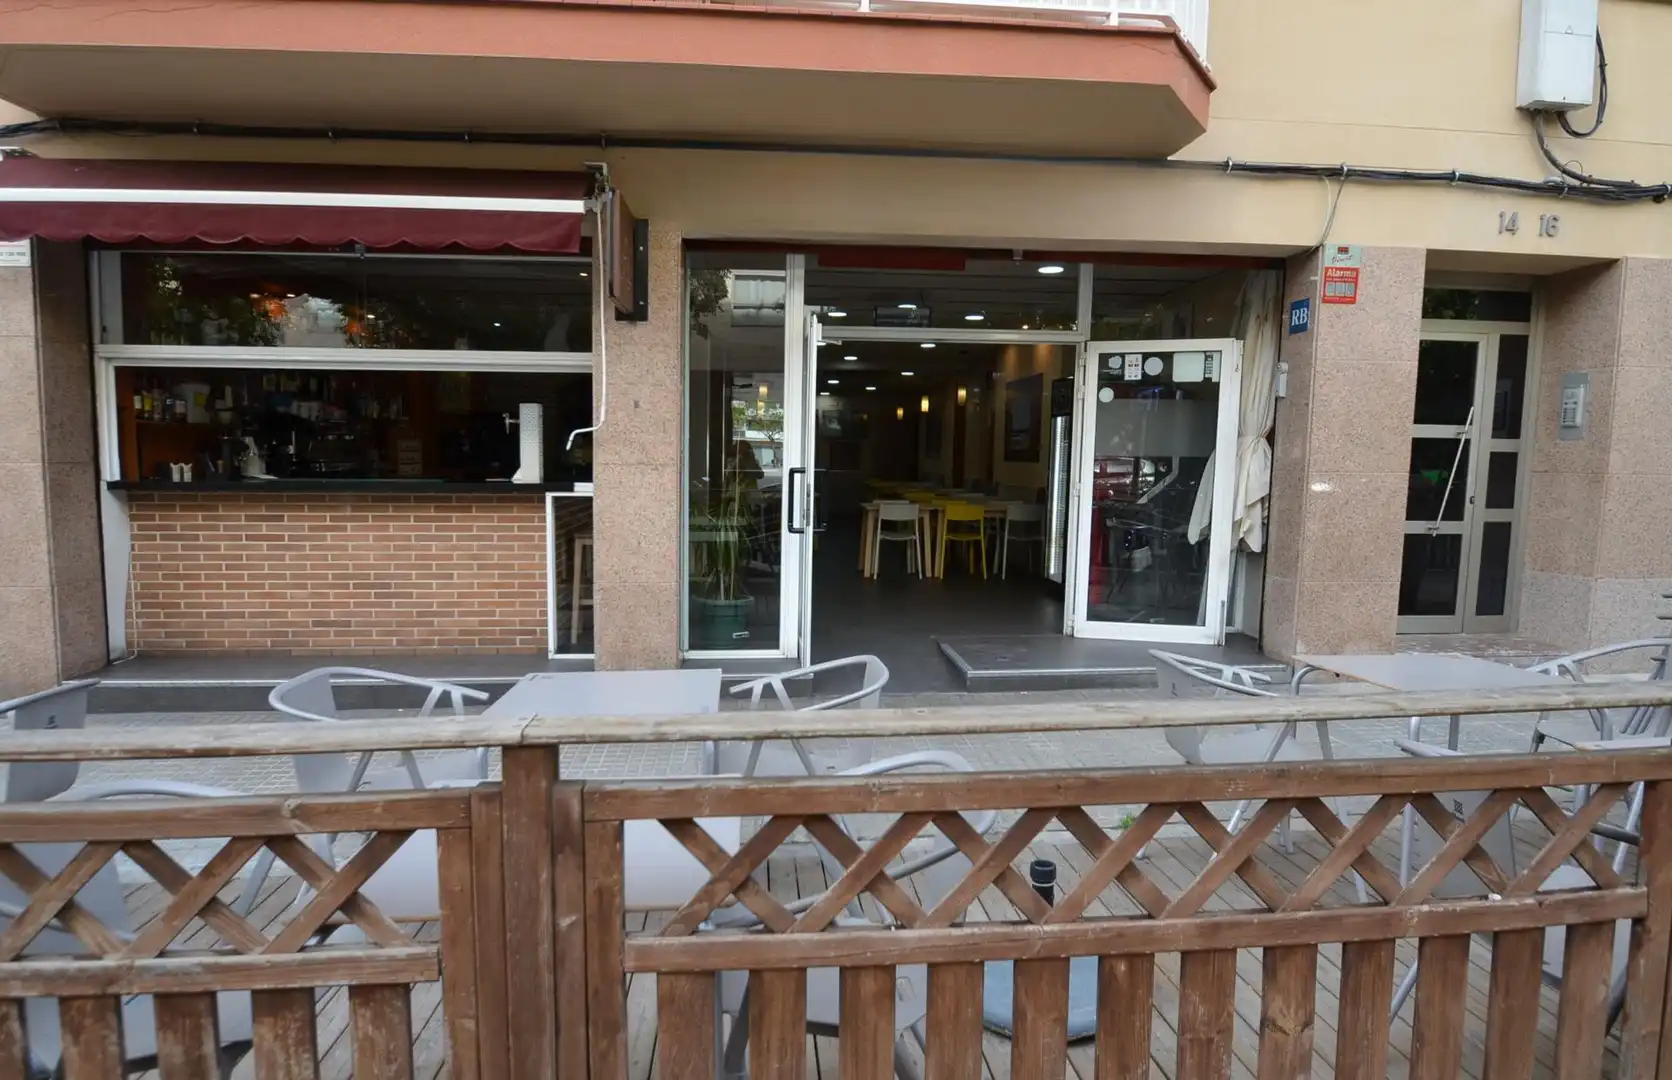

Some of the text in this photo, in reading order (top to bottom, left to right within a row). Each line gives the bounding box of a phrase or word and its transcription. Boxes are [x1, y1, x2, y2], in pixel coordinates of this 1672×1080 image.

[1498, 209, 1560, 238] 14 16
[1326, 268, 1357, 278] Alarma
[1291, 307, 1308, 326] RB
